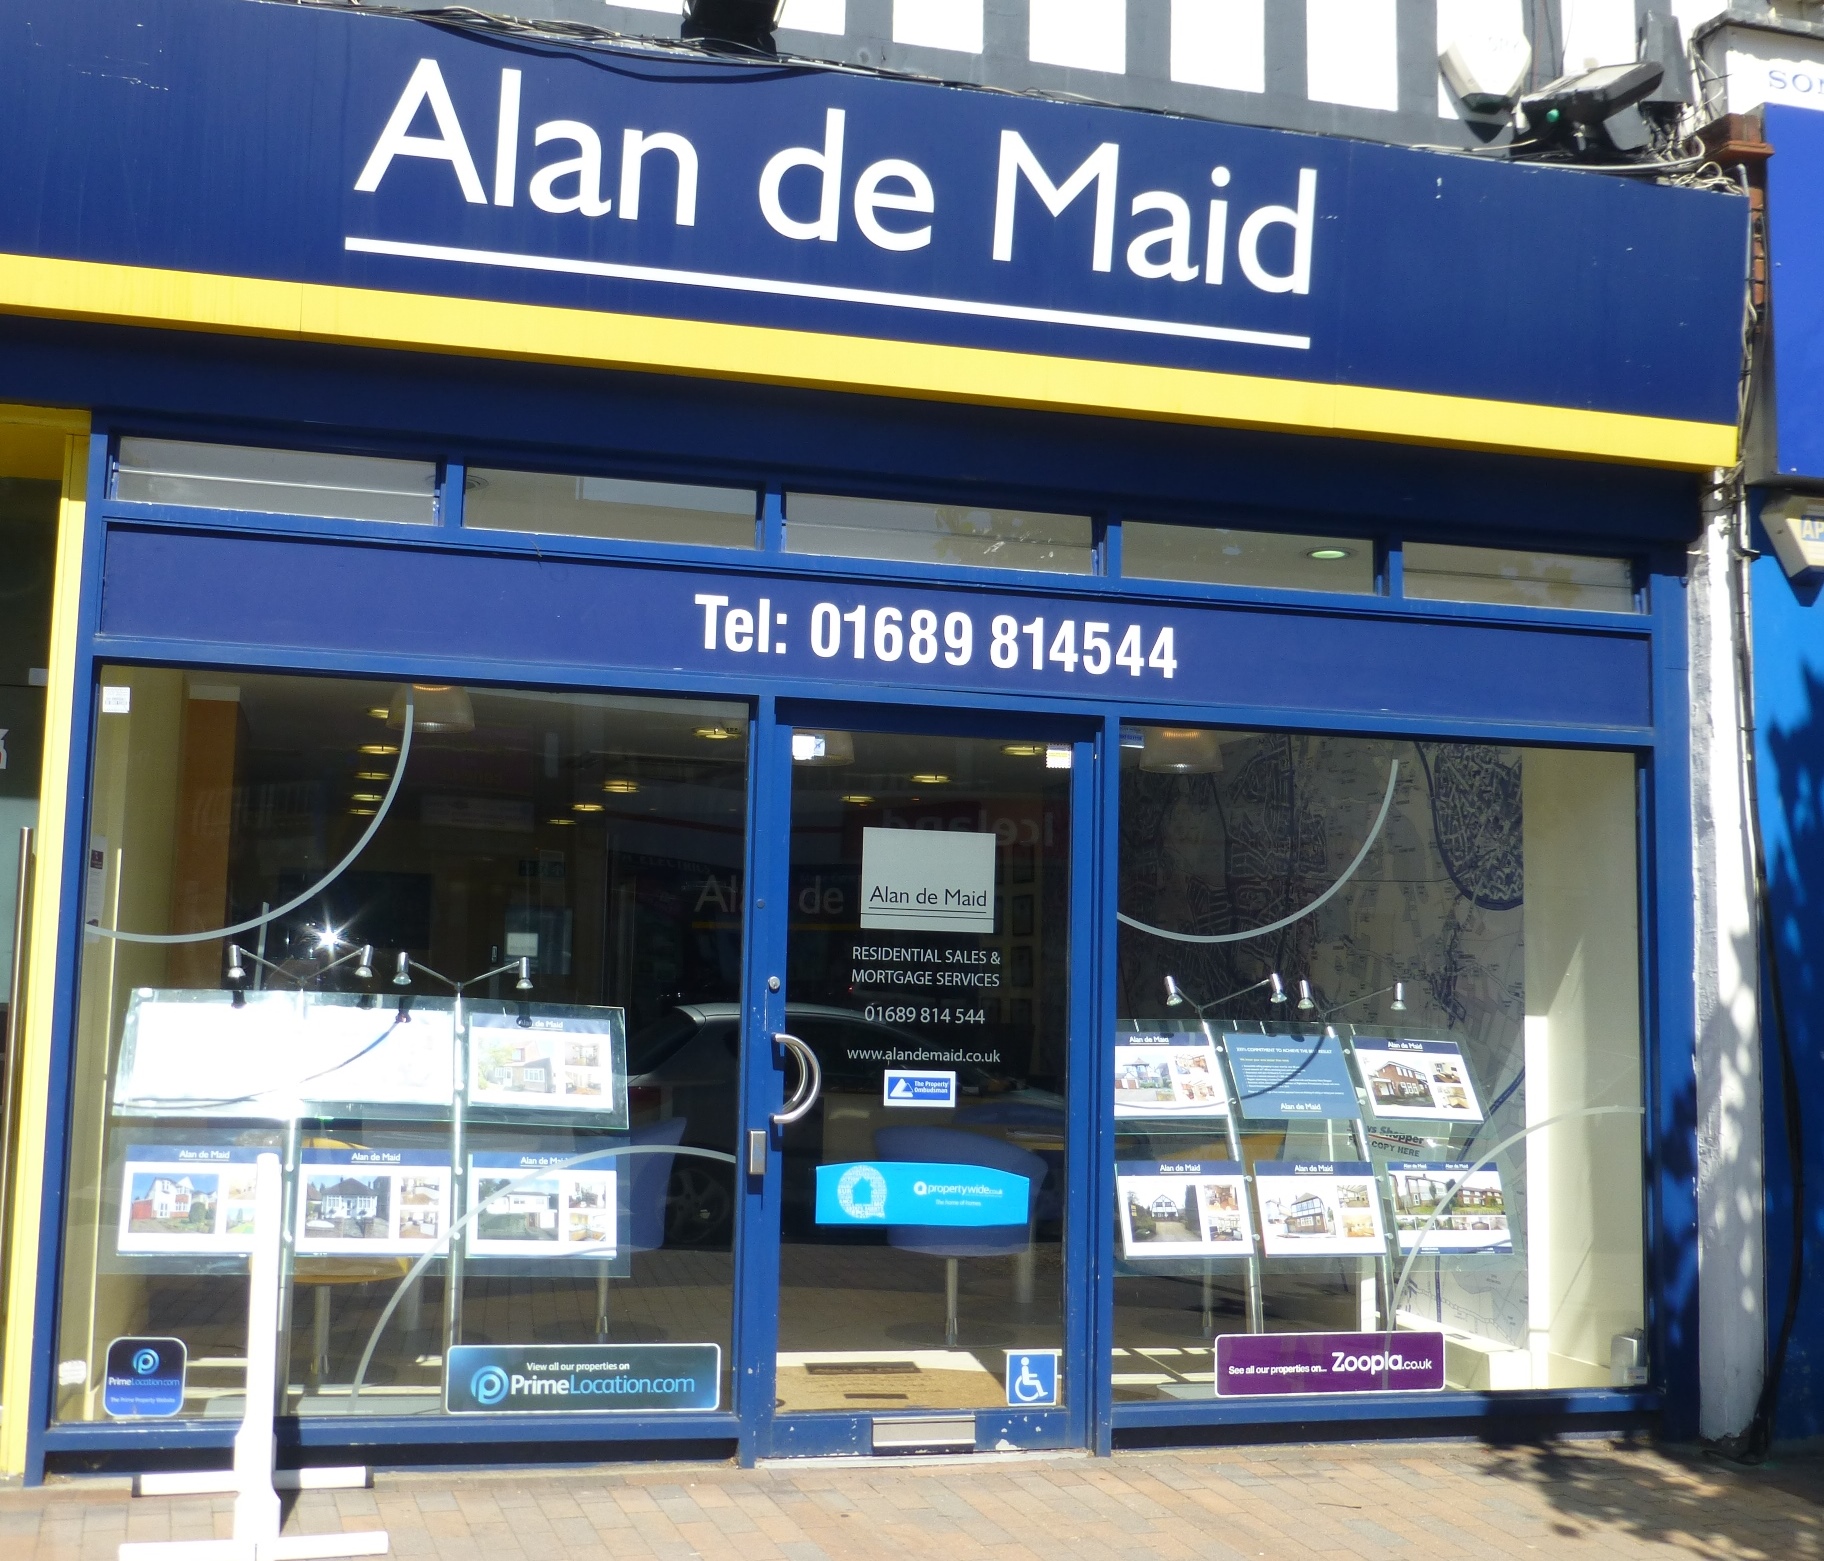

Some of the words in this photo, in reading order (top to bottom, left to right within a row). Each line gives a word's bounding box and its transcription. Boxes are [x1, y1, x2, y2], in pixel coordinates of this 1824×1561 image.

[353, 58, 700, 227] Alan
[758, 108, 935, 252] de
[992, 129, 1317, 295] Maid
[694, 593, 788, 655] Tel:
[809, 602, 974, 666] 01689
[990, 614, 1178, 678] 814544
[869, 885, 910, 904] Alan
[916, 887, 938, 905] de
[944, 888, 987, 907] Maid
[852, 946, 942, 963] RESIDENTIAL
[945, 950, 987, 964] SALES
[990, 951, 1001, 965] &
[851, 969, 933, 985] MORTGAGE
[936, 972, 1000, 987] SERVICES
[864, 1006, 916, 1023] 01689
[920, 1007, 951, 1023] 814
[955, 1009, 985, 1024] 544
[847, 1047, 1001, 1063] www.alandemaid.co.uk
[925, 1081, 949, 1089] Property
[1280, 1102, 1295, 1110] Alan
[1379, 1126, 1424, 1145] Shopper
[179, 1150, 197, 1159] Alan
[198, 1151, 209, 1159] de
[210, 1151, 230, 1160] Maid
[1371, 1140, 1396, 1152] COPY
[1397, 1147, 1420, 1157] HERE
[351, 1152, 369, 1161] Alan
[370, 1153, 381, 1161] de
[382, 1153, 401, 1162] Maid
[520, 1156, 537, 1164] Alan
[539, 1157, 548, 1165] de
[1160, 1164, 1175, 1172] Alan
[1175, 1164, 1184, 1172] de
[1185, 1164, 1201, 1172] Maid
[1319, 1165, 1333, 1173] Maid
[527, 1362, 546, 1371] View
[548, 1362, 559, 1371] all
[560, 1363, 574, 1371] our
[576, 1362, 617, 1373] properties
[619, 1363, 630, 1371] on
[1228, 1365, 1245, 1375] See
[1245, 1365, 1255, 1374] all
[1256, 1366, 1269, 1374] our
[1270, 1364, 1309, 1375] properties
[1332, 1351, 1432, 1375] Zoopla.co.uk
[108, 1376, 180, 1386] PrimeLocation.com
[511, 1374, 695, 1395] PrimeLocation.com
